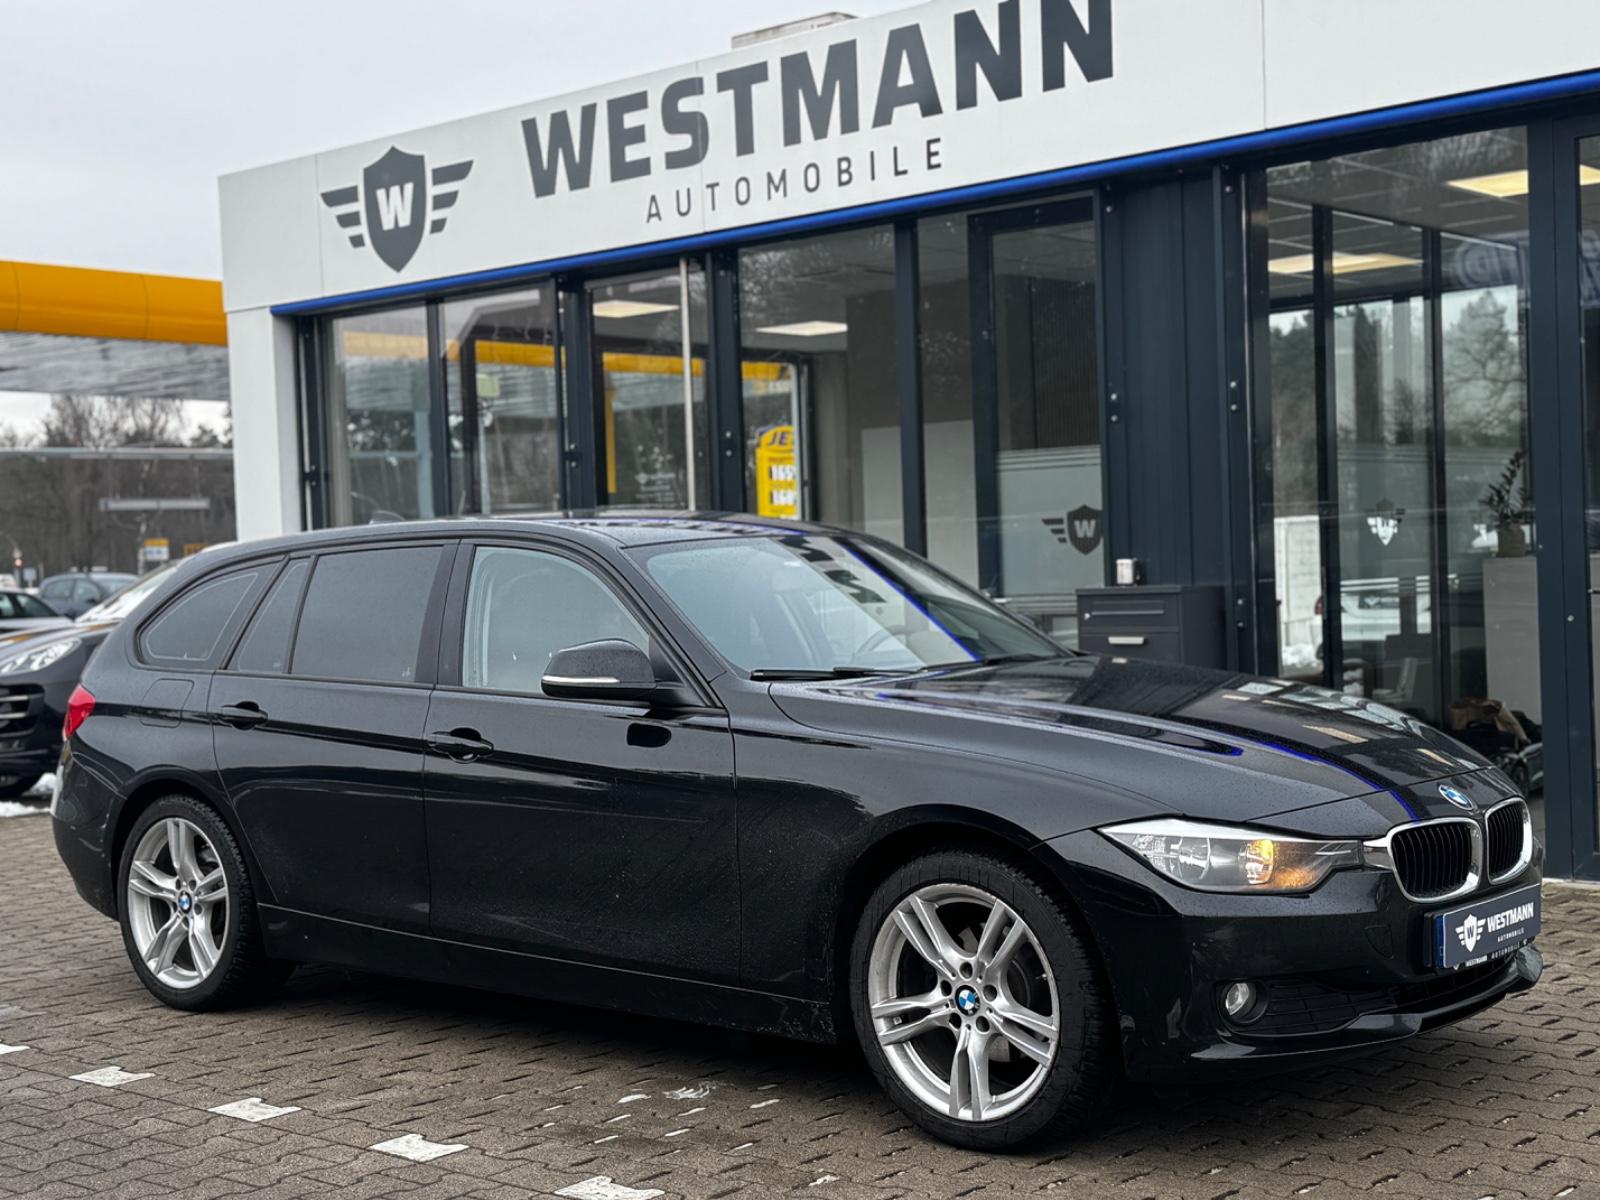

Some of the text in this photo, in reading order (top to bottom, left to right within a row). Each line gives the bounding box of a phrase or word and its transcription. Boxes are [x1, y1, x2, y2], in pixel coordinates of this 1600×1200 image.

[521, 0, 1113, 198] WESTMANN
[646, 137, 942, 224] AUTOMOBILE
[376, 182, 414, 231] W
[1074, 519, 1096, 538] W
[1466, 924, 1475, 940] W
[1487, 902, 1534, 933] WESTMANN
